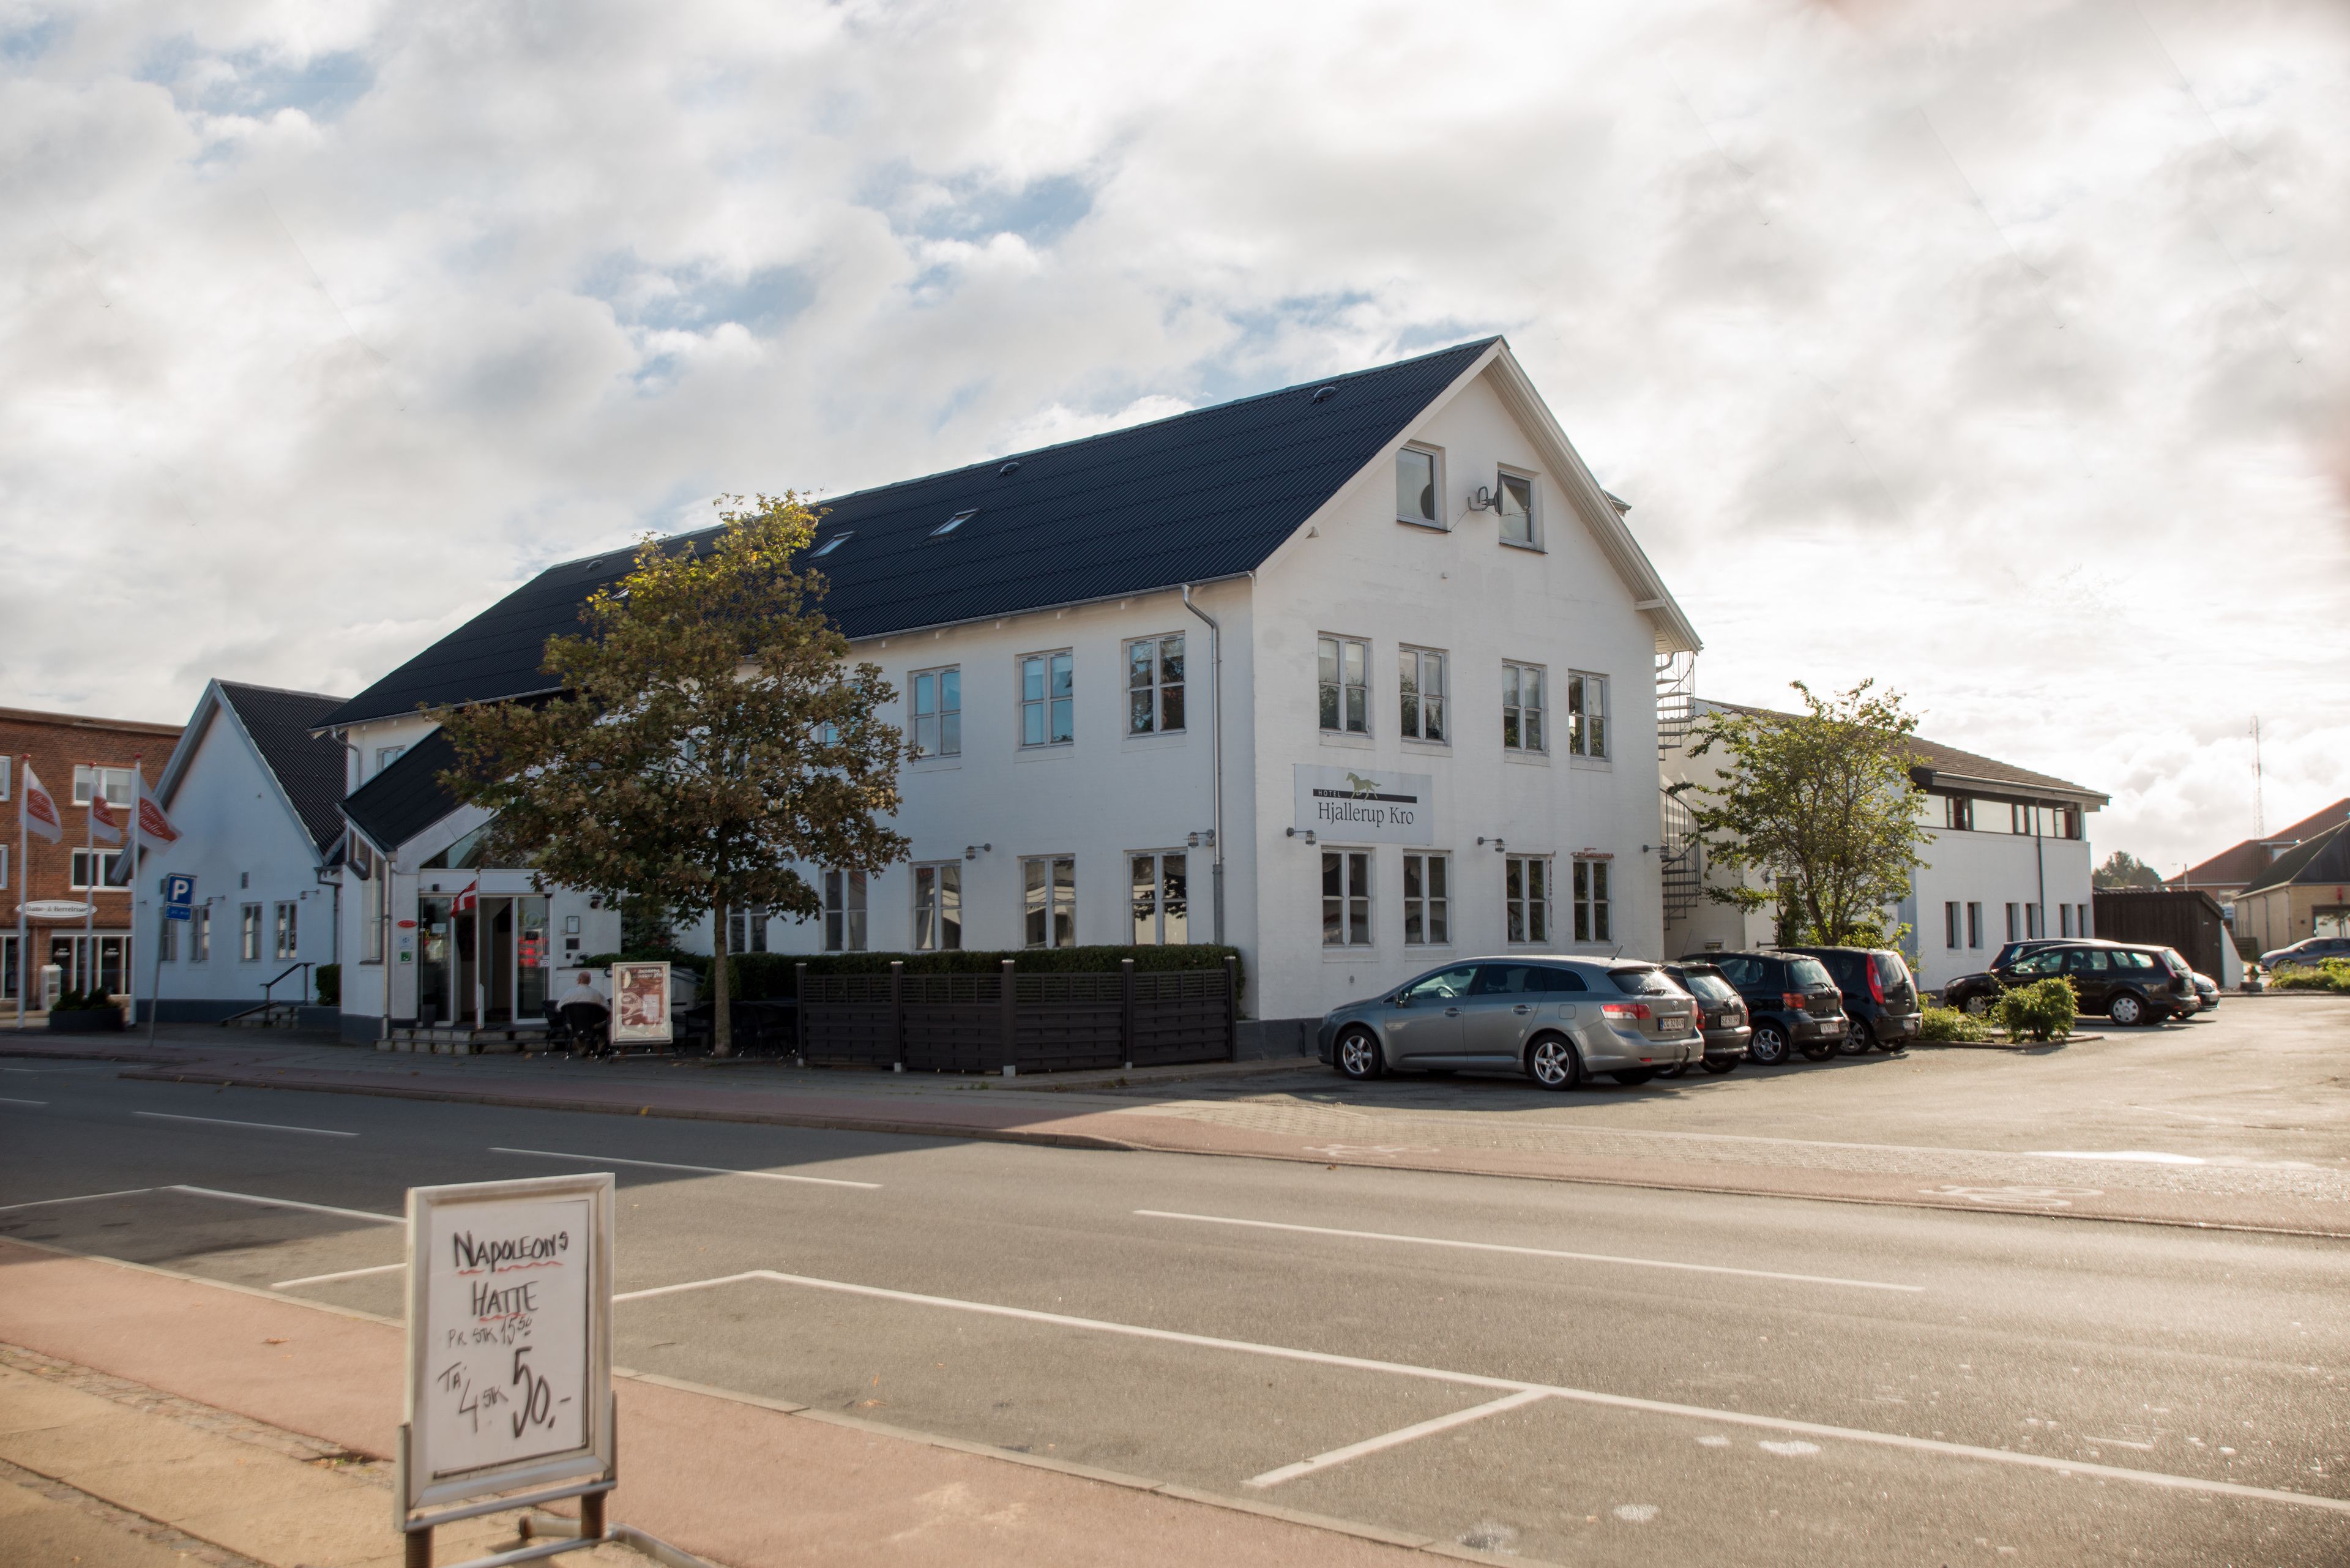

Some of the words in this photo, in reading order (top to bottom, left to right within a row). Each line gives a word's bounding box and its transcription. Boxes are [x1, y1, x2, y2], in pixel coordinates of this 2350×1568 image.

[1318, 790, 1341, 798] HOTEL
[1318, 802, 1384, 827] Hjallerup
[1389, 806, 1414, 825] Kro
[172, 879, 189, 901] P
[1670, 1018, 1676, 1027] 32
[472, 1280, 540, 1316] HATTE
[449, 1328, 468, 1348] PR
[473, 1327, 498, 1343] STK
[459, 1378, 479, 1433] 4
[482, 1386, 509, 1408] STK
